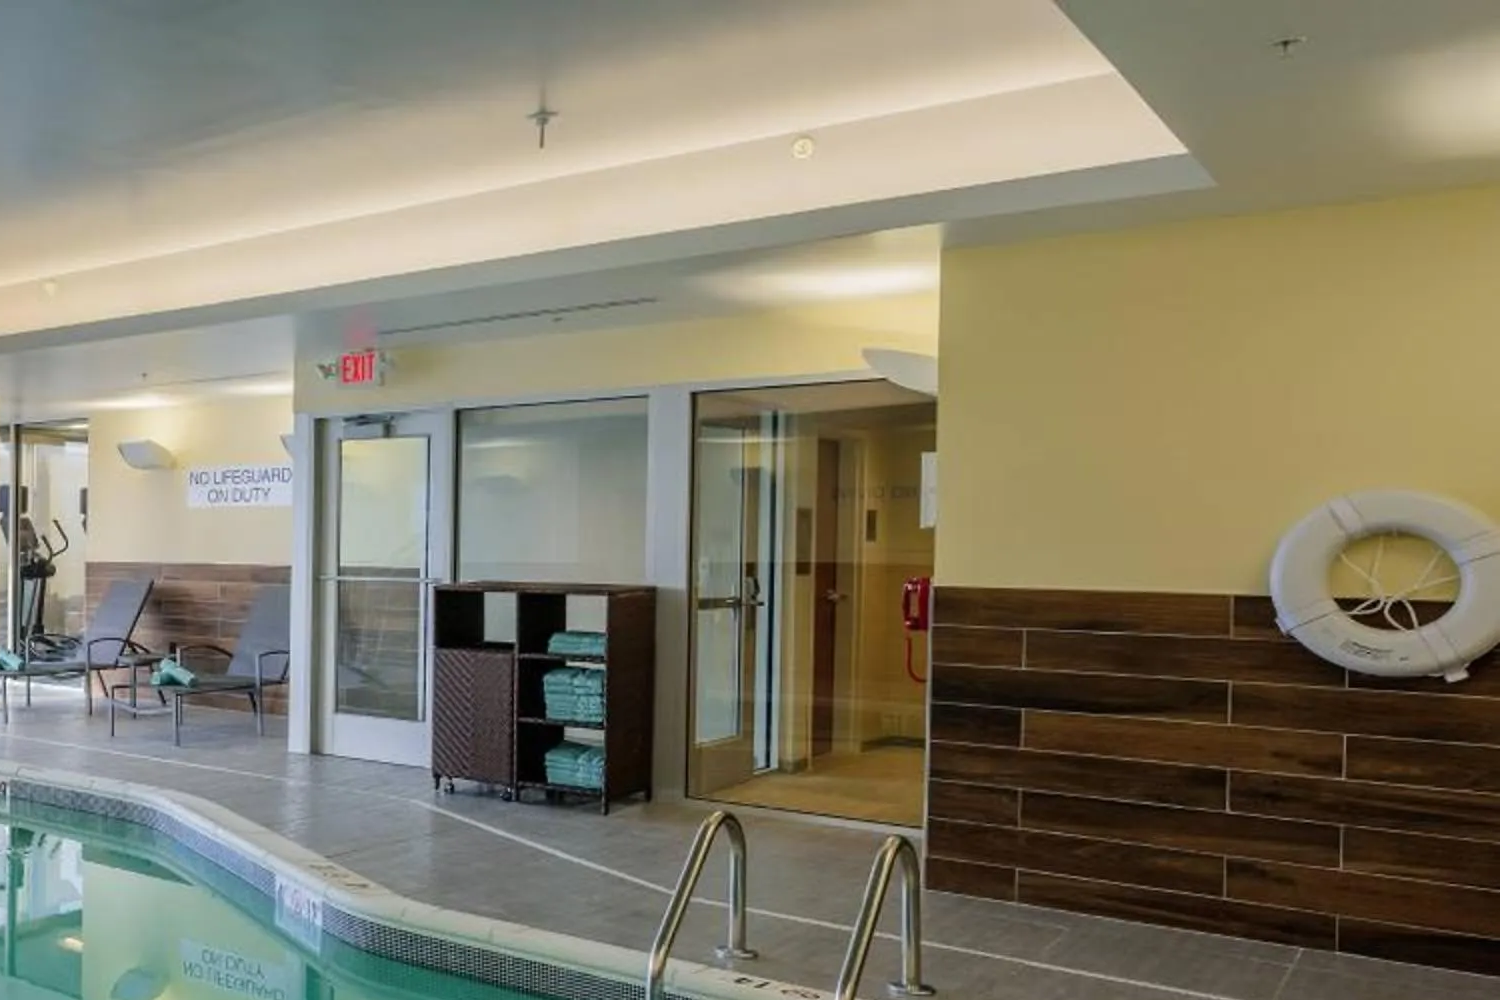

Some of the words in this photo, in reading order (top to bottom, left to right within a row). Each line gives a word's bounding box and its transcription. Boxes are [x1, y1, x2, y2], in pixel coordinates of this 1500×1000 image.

[342, 353, 375, 383] EXIT
[189, 471, 209, 485] NO
[213, 467, 293, 485] LIFEGUARD
[207, 488, 228, 503] ON
[232, 487, 271, 503] DUTY
